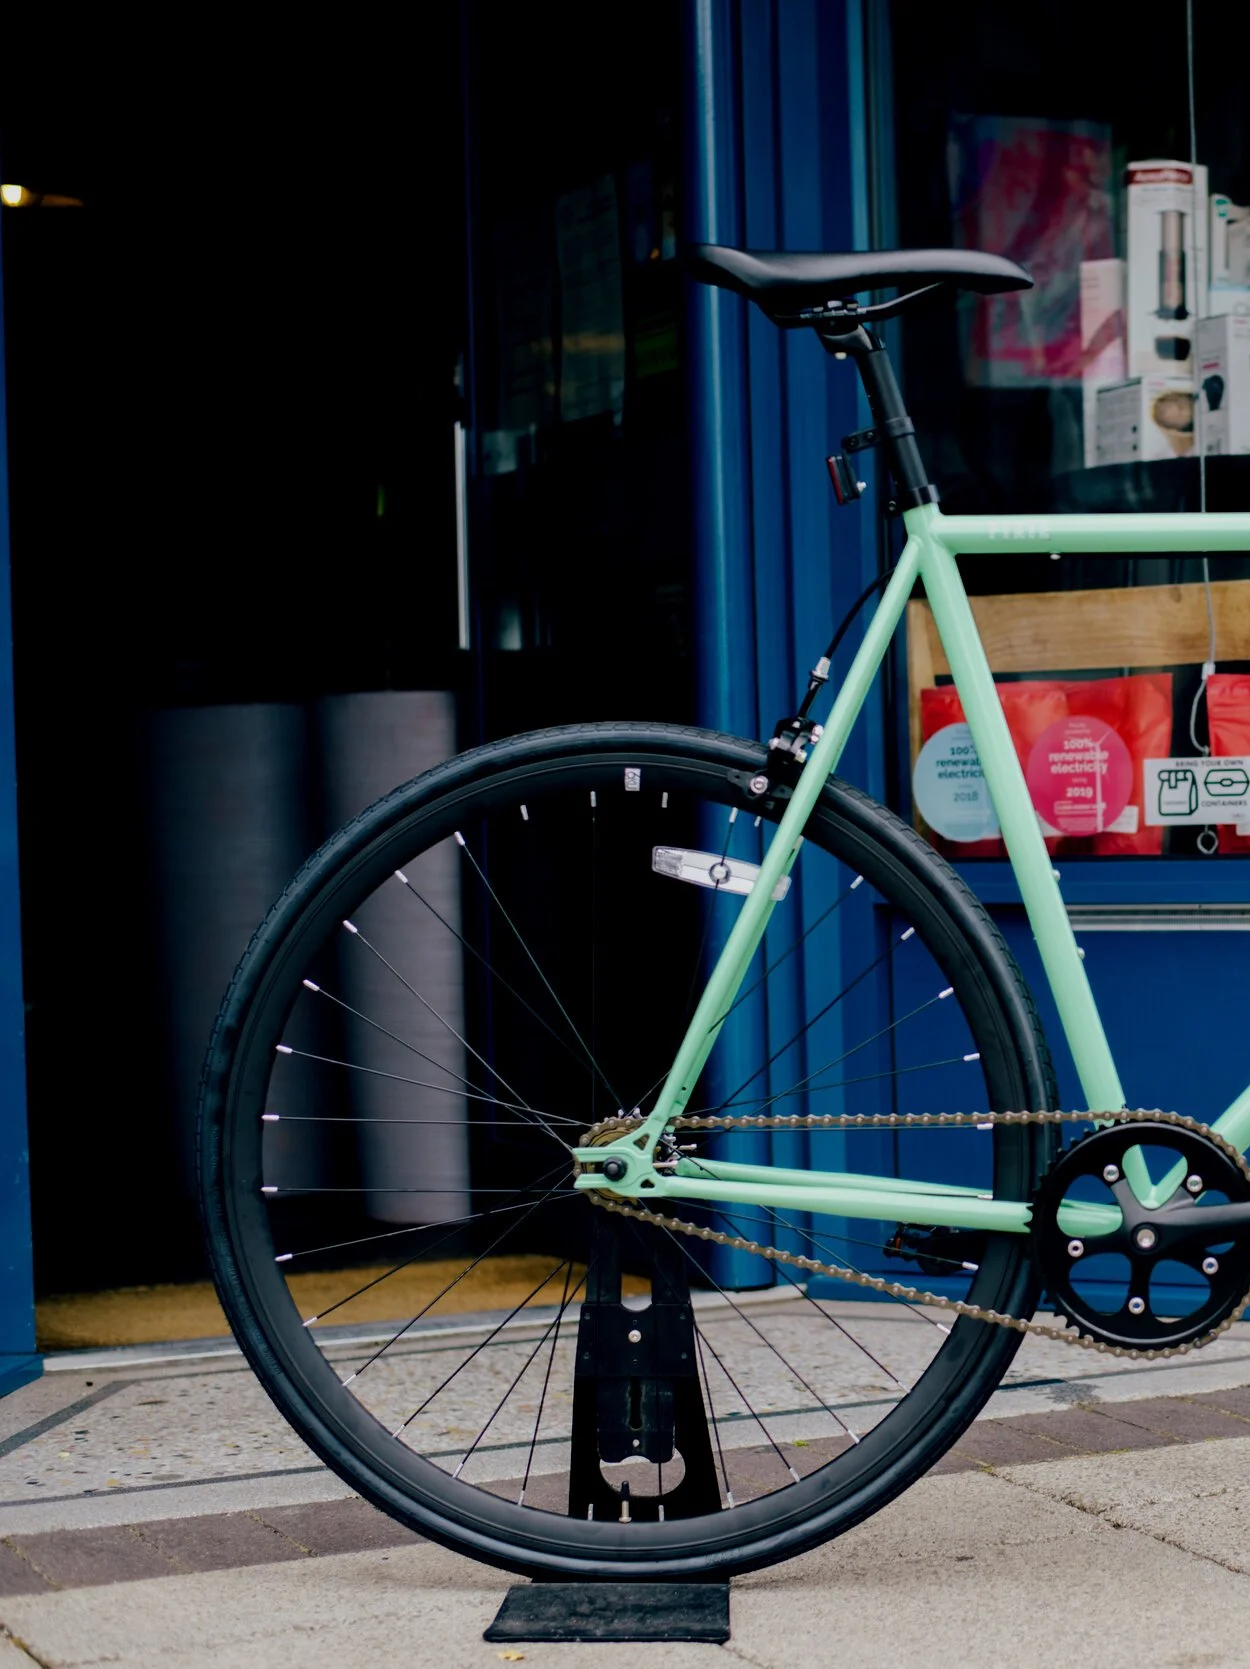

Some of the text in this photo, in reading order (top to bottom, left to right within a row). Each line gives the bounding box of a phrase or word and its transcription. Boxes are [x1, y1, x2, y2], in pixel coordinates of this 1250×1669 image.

[1063, 738, 1094, 750] 100%
[1050, 763, 1108, 775] electricity
[953, 791, 979, 802] 2018
[1066, 786, 1094, 798] 2019
